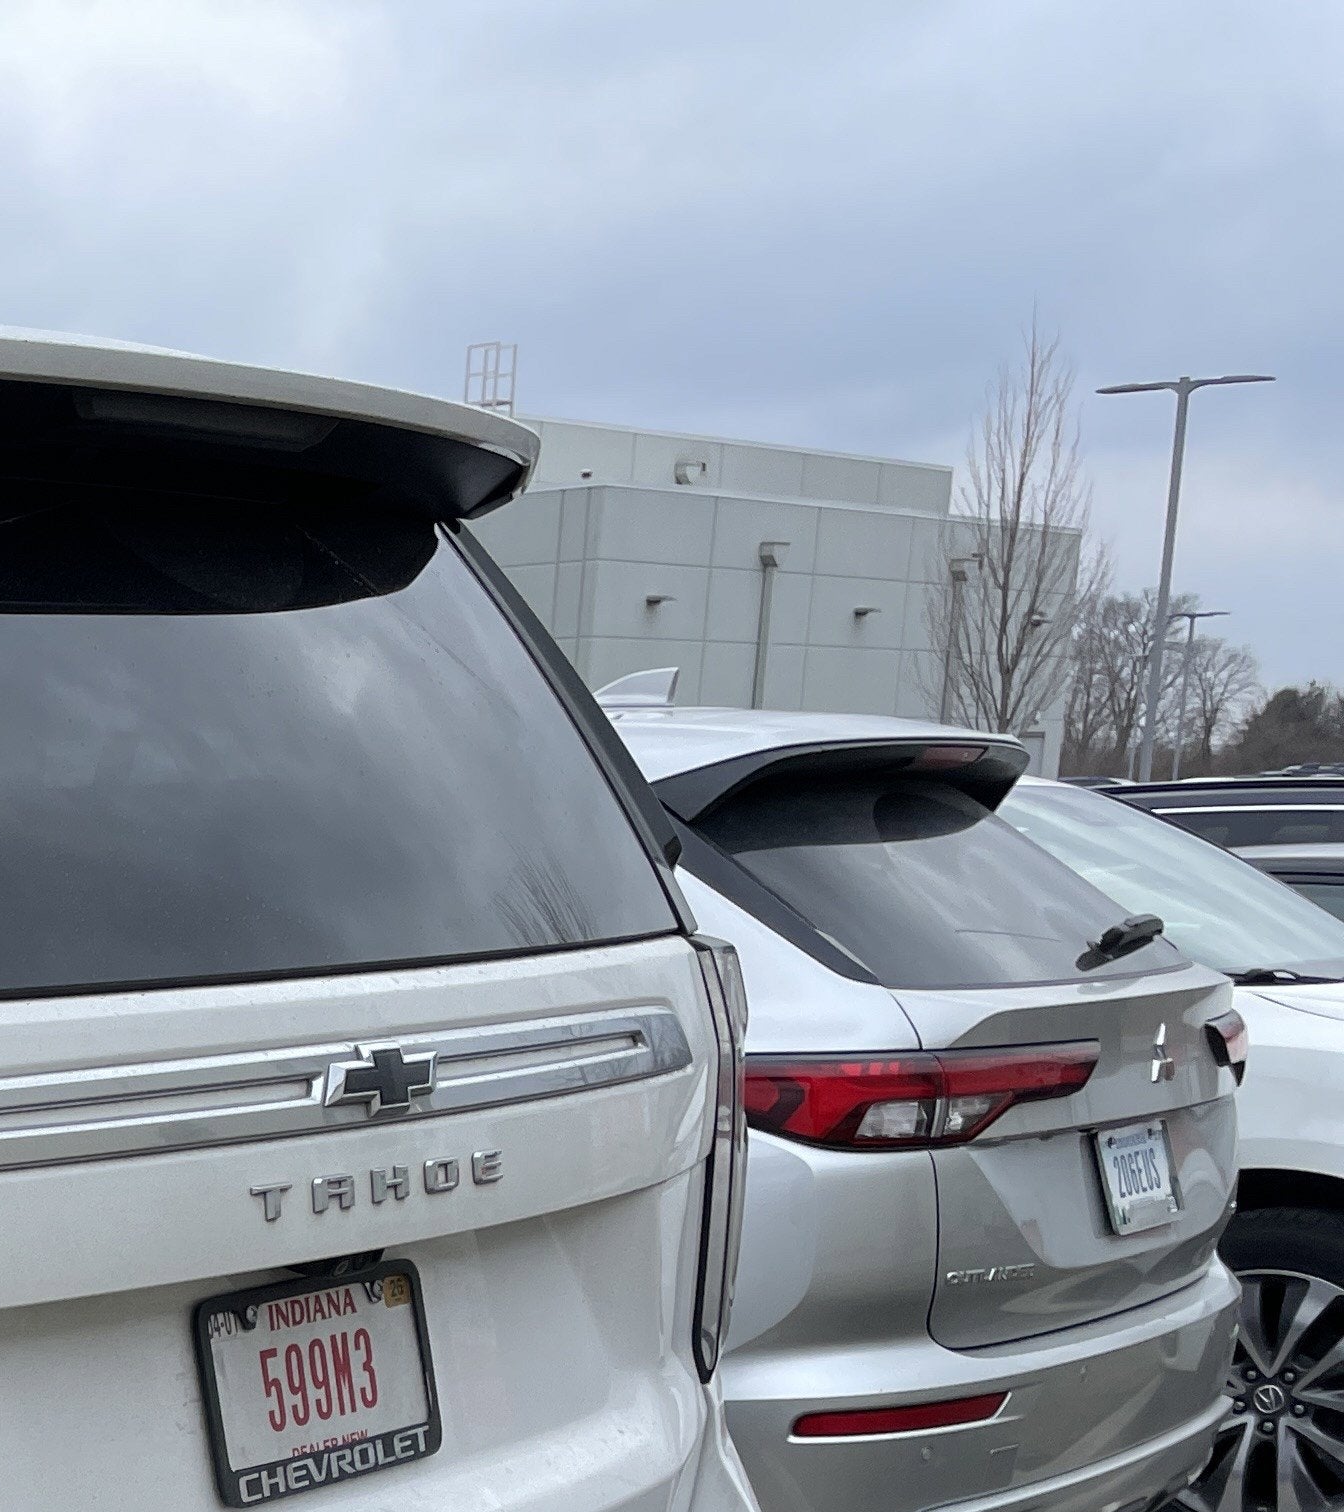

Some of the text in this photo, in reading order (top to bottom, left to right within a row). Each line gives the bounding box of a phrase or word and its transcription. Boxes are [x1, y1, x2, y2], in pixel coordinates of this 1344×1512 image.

[249, 1149, 504, 1223] TAHOE
[267, 1288, 358, 1332] INDIANA
[258, 1327, 379, 1433] 599M3
[237, 1424, 430, 1503] CHEVROLET
